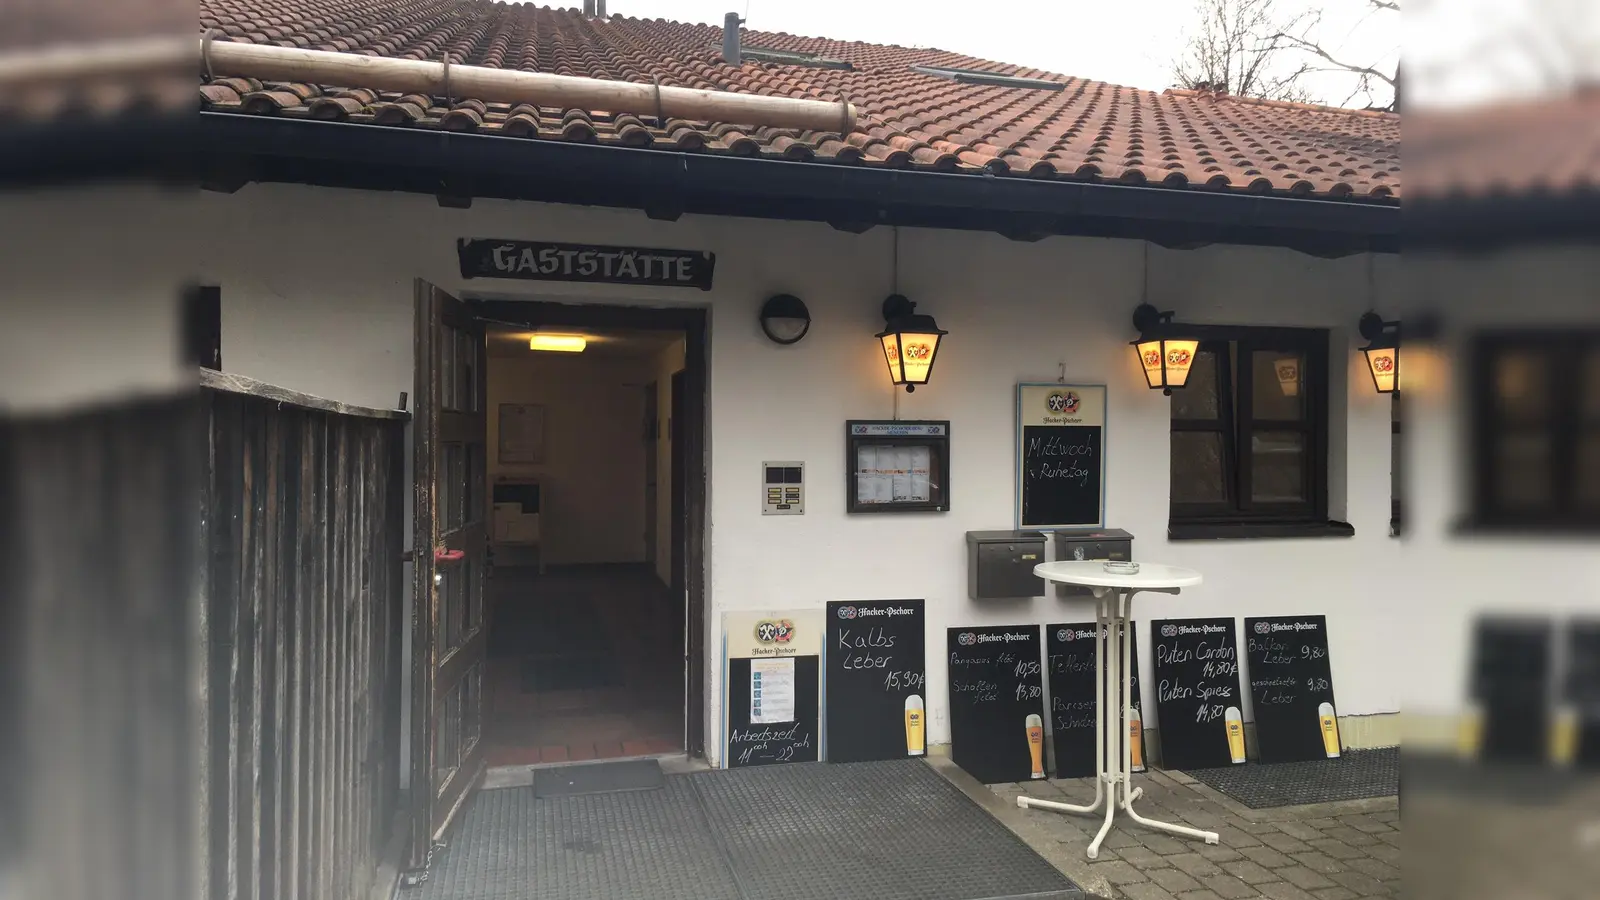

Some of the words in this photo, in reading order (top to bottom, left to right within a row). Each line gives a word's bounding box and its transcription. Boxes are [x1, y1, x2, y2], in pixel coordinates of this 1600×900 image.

[493, 243, 693, 281] GASTSTÄTTE
[1043, 416, 1082, 425] Hacker-Pschorr
[1028, 434, 1092, 457] Mittwoch
[1040, 460, 1089, 487] Ruhetag
[858, 606, 914, 618] Hacker-Pschorr
[1179, 624, 1226, 635] Hacker-Pschorr
[1271, 622, 1318, 632] Hacker-Pschorr
[839, 627, 897, 649] Kalbs
[977, 632, 1030, 643] Hacker-Pschorr
[752, 647, 797, 656] Hacker-Pschorr
[1157, 641, 1192, 667] Puten
[1196, 637, 1235, 660] Cordon
[1264, 652, 1297, 664] Leber
[1301, 645, 1325, 660] 9,80
[843, 652, 892, 669] Leber
[1014, 660, 1041, 679] 10,50
[1158, 677, 1192, 703] Puten
[1196, 681, 1232, 700] Spiess
[1261, 690, 1297, 705] Leber
[1196, 704, 1224, 723] 14,80
